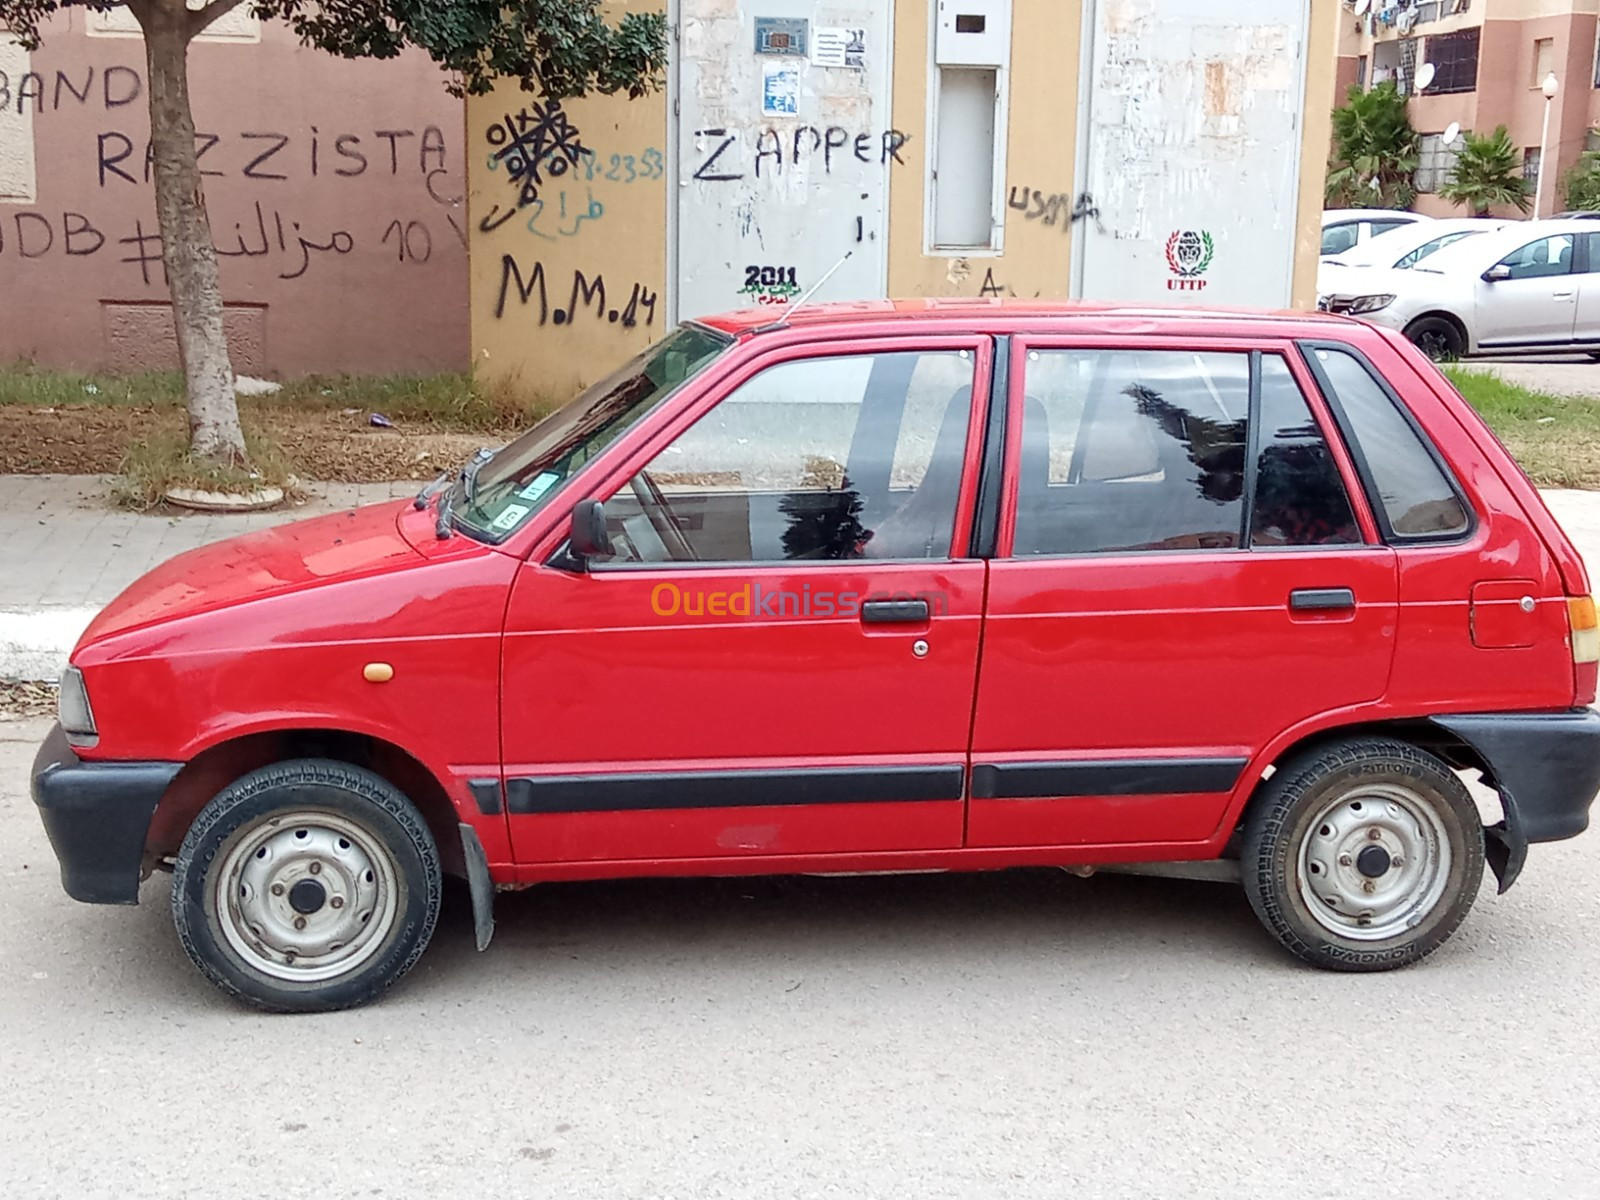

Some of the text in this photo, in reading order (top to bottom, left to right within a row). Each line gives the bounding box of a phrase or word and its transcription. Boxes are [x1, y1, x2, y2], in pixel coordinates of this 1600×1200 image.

[0, 212, 106, 258] DB
[745, 265, 797, 287] 2011
[1167, 279, 1207, 290] UTTP
